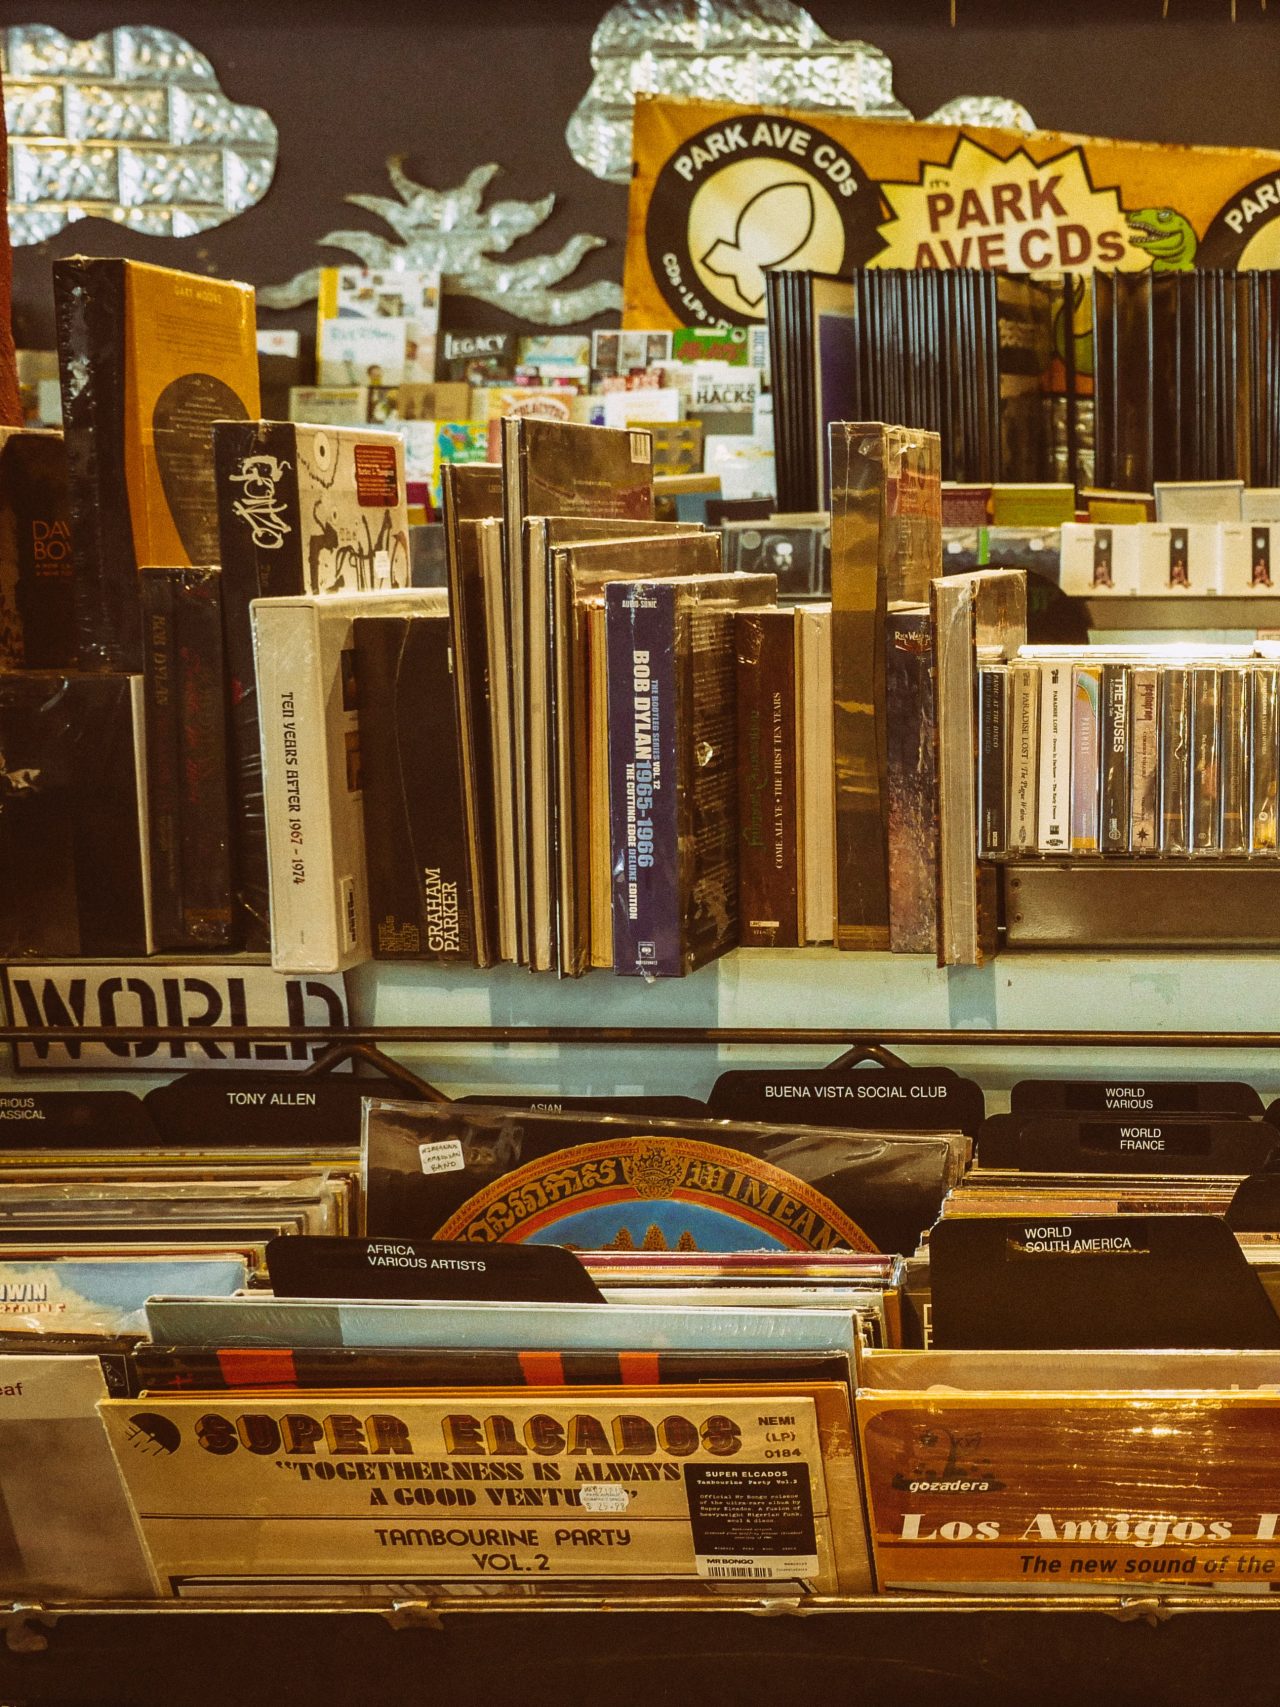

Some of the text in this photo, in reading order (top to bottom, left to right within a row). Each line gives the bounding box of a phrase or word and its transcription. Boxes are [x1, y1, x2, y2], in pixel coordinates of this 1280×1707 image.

[673, 122, 860, 198] PARK AVE CDs
[926, 175, 1067, 232] PARK
[914, 223, 1126, 270] AVE CDs
[662, 252, 684, 293] CDs
[444, 331, 507, 360] LEGACY
[697, 384, 757, 404] HACKS
[651, 696, 660, 731] BOOTLEG
[1113, 677, 1124, 753] THE PAUSES
[773, 692, 783, 775] FIRST YEARS
[633, 650, 654, 868] BOB DYLAN 1965-1966
[281, 692, 305, 885] TEN YEARS AFTER 1967 1974
[626, 763, 638, 919] THE CUTTING EDGE DELUXE EDITION
[425, 867, 444, 951] GRAHAM
[441, 881, 460, 952] PARKER
[13, 977, 349, 1060] WORLD
[227, 1093, 316, 1105] TONY ALLEN
[764, 1085, 947, 1099] BUENA VISTA SOCIAL CLUB
[1105, 1088, 1145, 1098] WORLD
[1105, 1099, 1154, 1109] VARIOUS
[1120, 1128, 1162, 1139] WORLD
[1120, 1139, 1164, 1151] FRANCE
[1024, 1226, 1072, 1240] WORLD
[367, 1244, 415, 1256] AFRICA
[1025, 1236, 1132, 1253] SOUTH AMERICA
[368, 1256, 486, 1272] VARIOUS ARTISTS
[758, 1416, 796, 1427] NEMI
[194, 1413, 742, 1456] SUPER ELCADOS
[764, 1431, 796, 1443] (LP)
[764, 1448, 802, 1459] 0184
[534, 1462, 681, 1481] IS ALWAYS
[742, 1470, 788, 1478] ELCADOS
[909, 1479, 990, 1493] gozadera
[369, 1487, 477, 1507] A GOOD
[375, 1528, 632, 1547] TAMBOURINE PARTY
[899, 1513, 1001, 1541] Los
[1019, 1511, 1232, 1548] Amigos
[1020, 1556, 1062, 1575] The
[1070, 1560, 1115, 1575] new
[1125, 1556, 1196, 1575] sound
[1203, 1555, 1229, 1575] of
[1236, 1555, 1277, 1574] the
